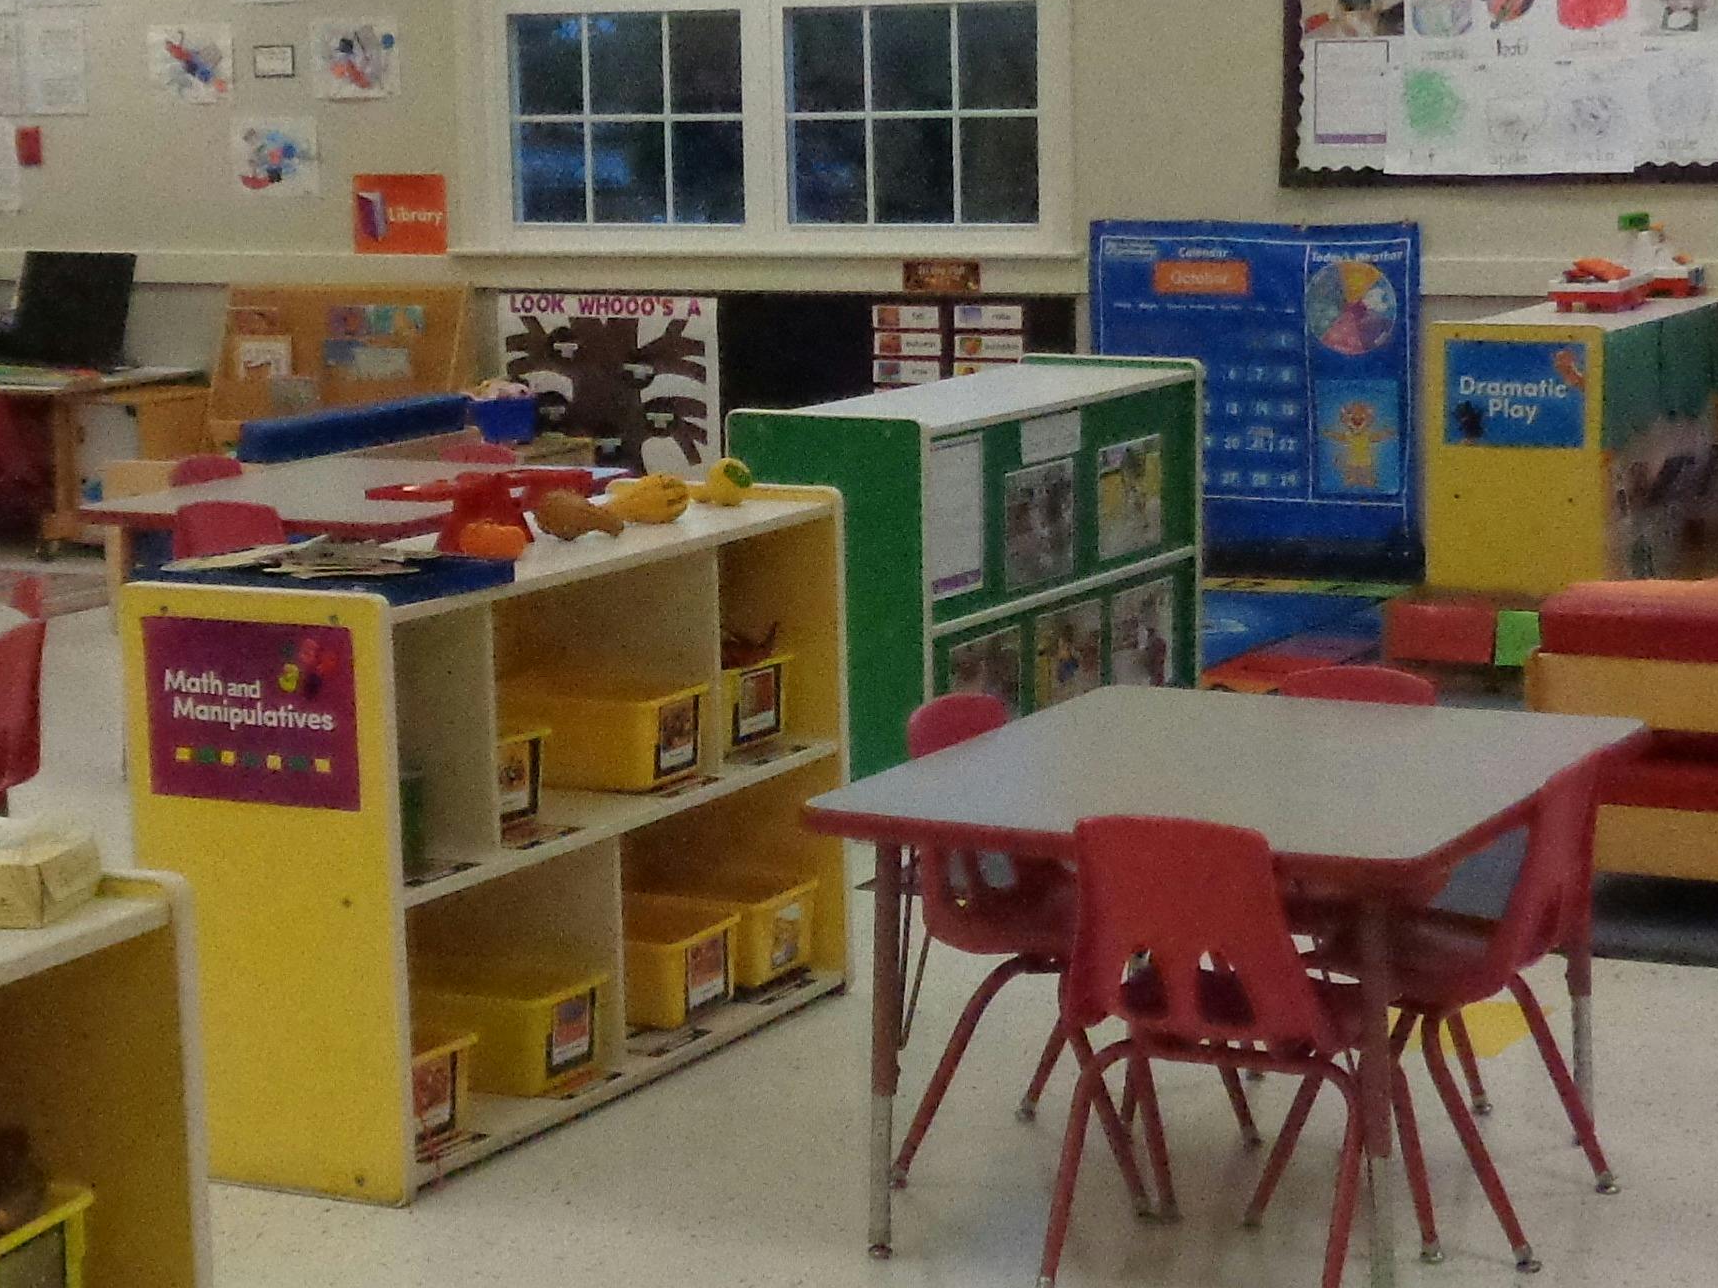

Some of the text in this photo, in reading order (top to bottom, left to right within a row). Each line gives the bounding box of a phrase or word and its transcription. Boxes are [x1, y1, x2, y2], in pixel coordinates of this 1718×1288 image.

[388, 205, 444, 227] Library
[1177, 246, 1229, 259] Calendar
[1170, 271, 1230, 286] October
[509, 294, 702, 317] LOOK WHOOO'S A
[1459, 375, 1568, 398] Dramatic
[1488, 398, 1537, 424] Play
[163, 668, 262, 699] Math and
[172, 695, 336, 732] Manipulatives
